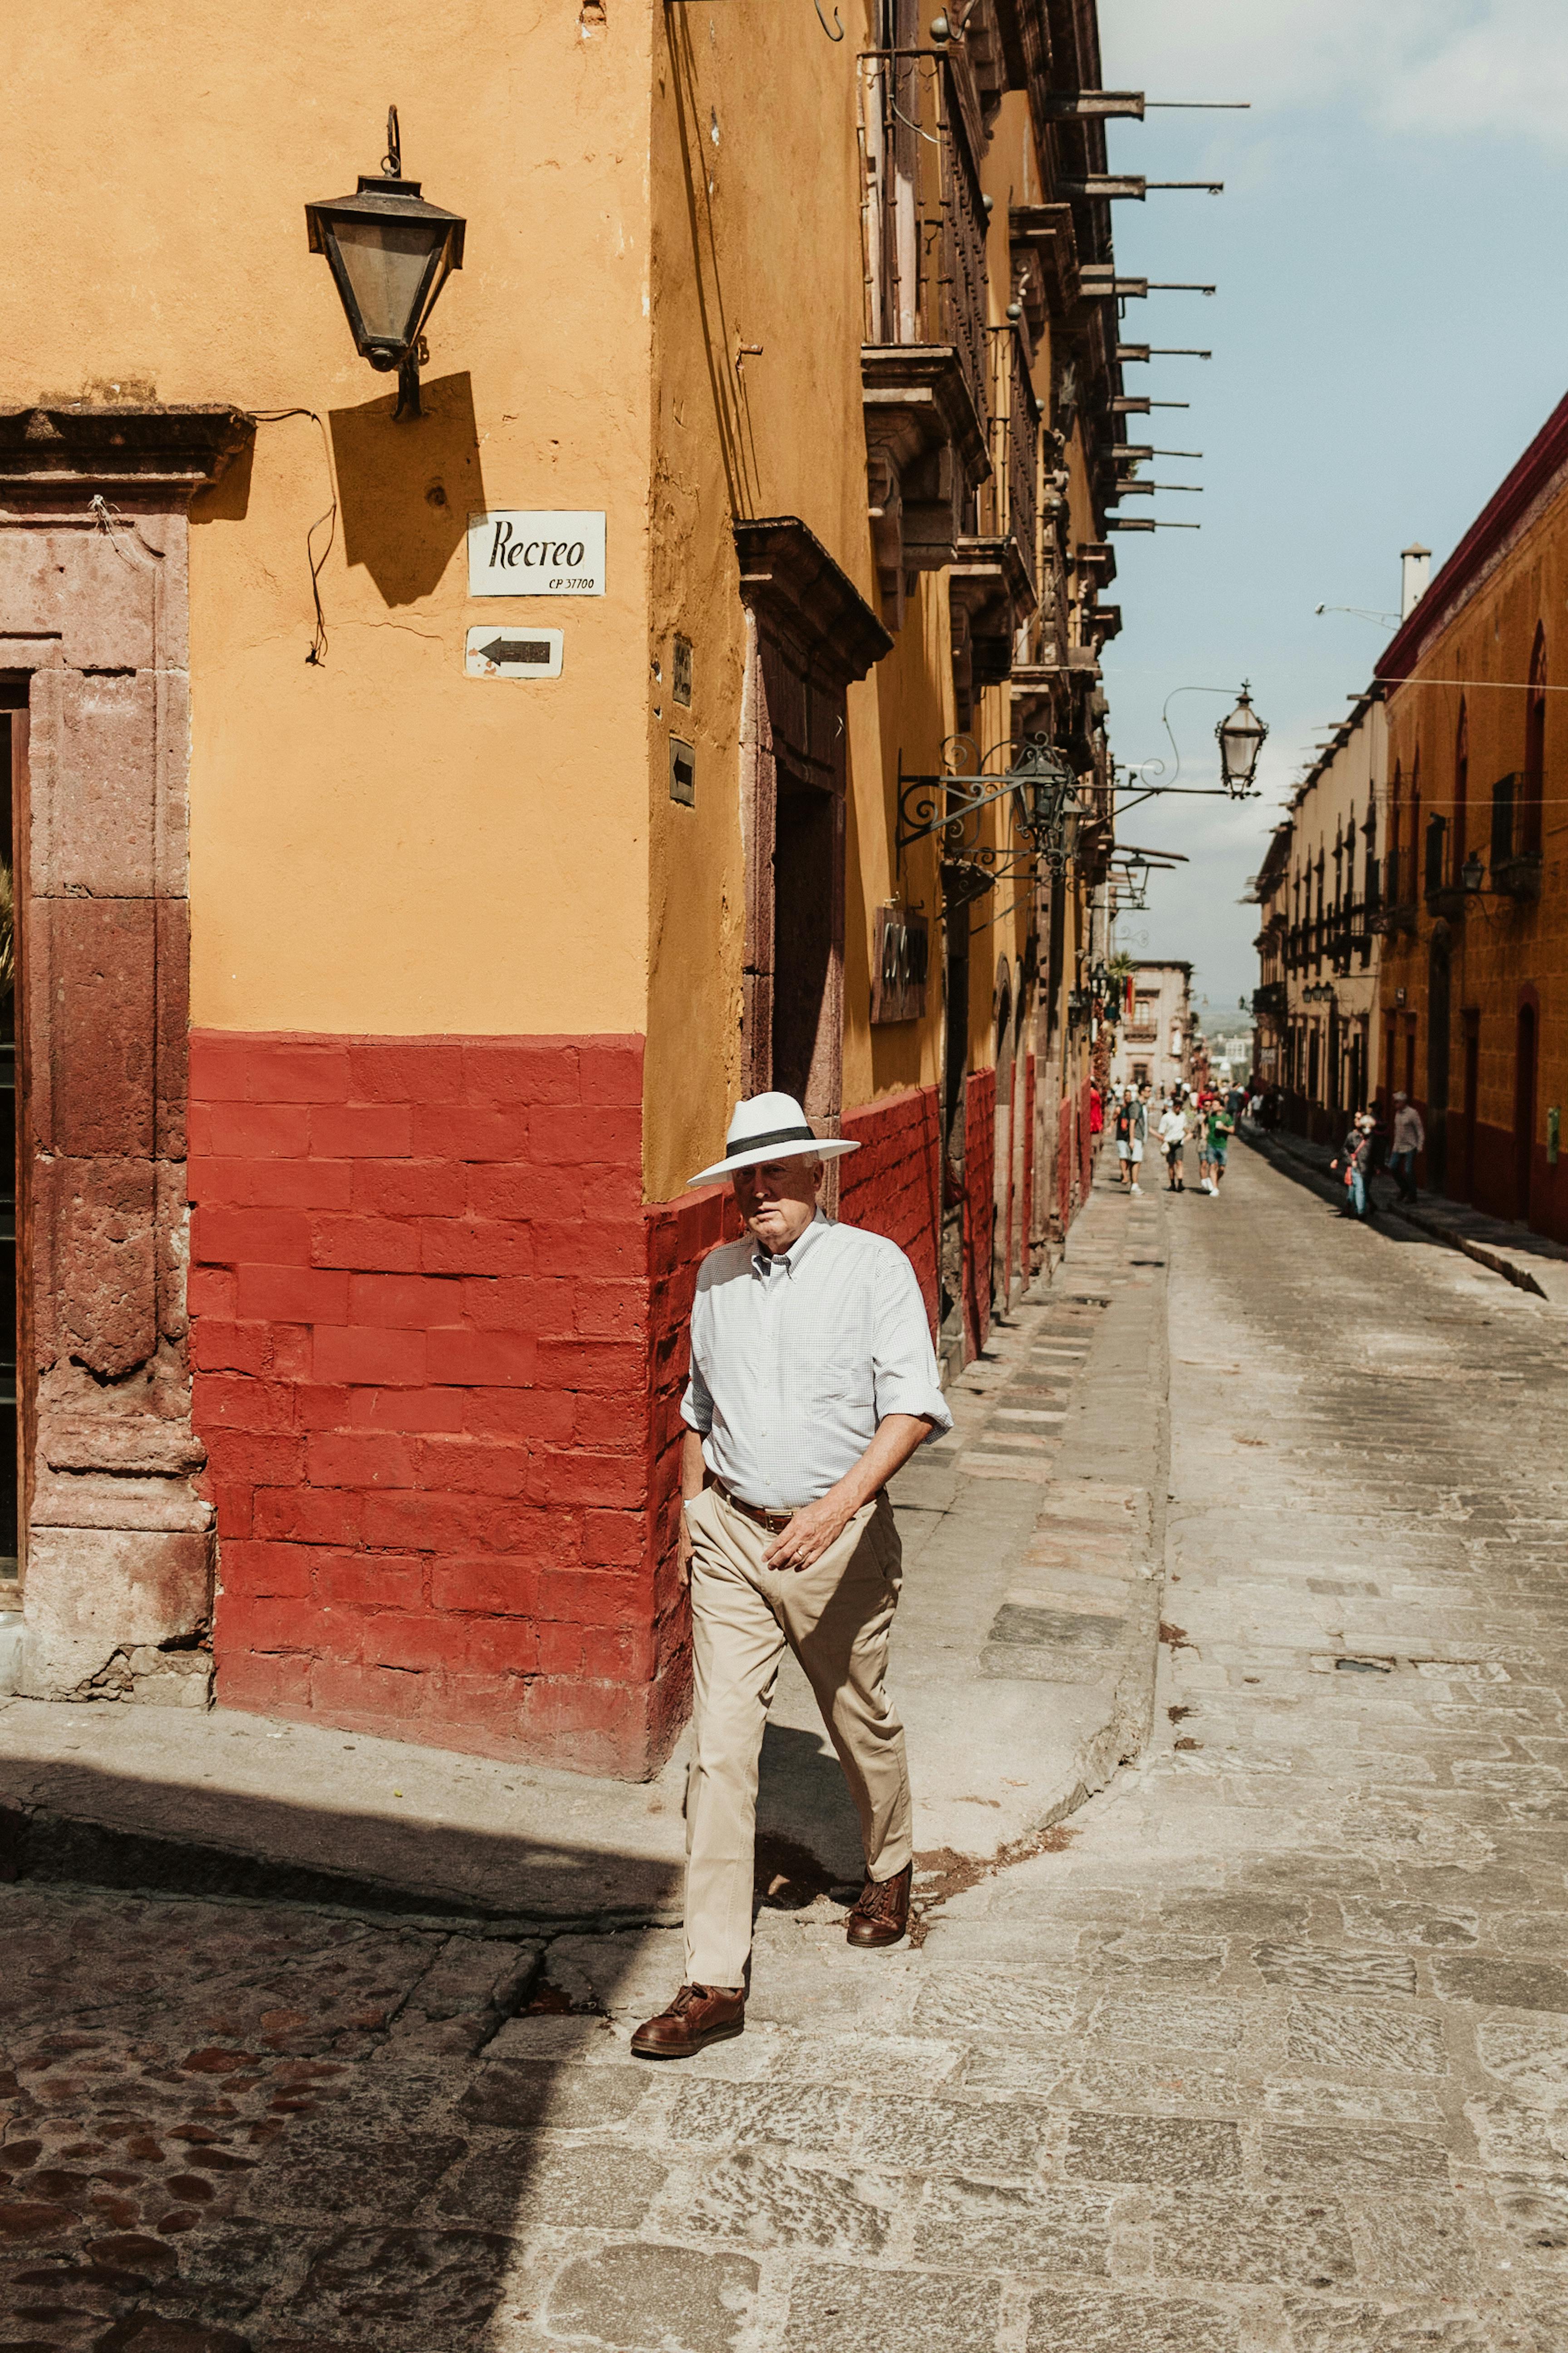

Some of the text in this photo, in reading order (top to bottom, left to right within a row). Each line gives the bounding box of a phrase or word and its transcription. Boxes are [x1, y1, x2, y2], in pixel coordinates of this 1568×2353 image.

[489, 521, 584, 569] Recreo
[549, 579, 594, 589] CP 37700
